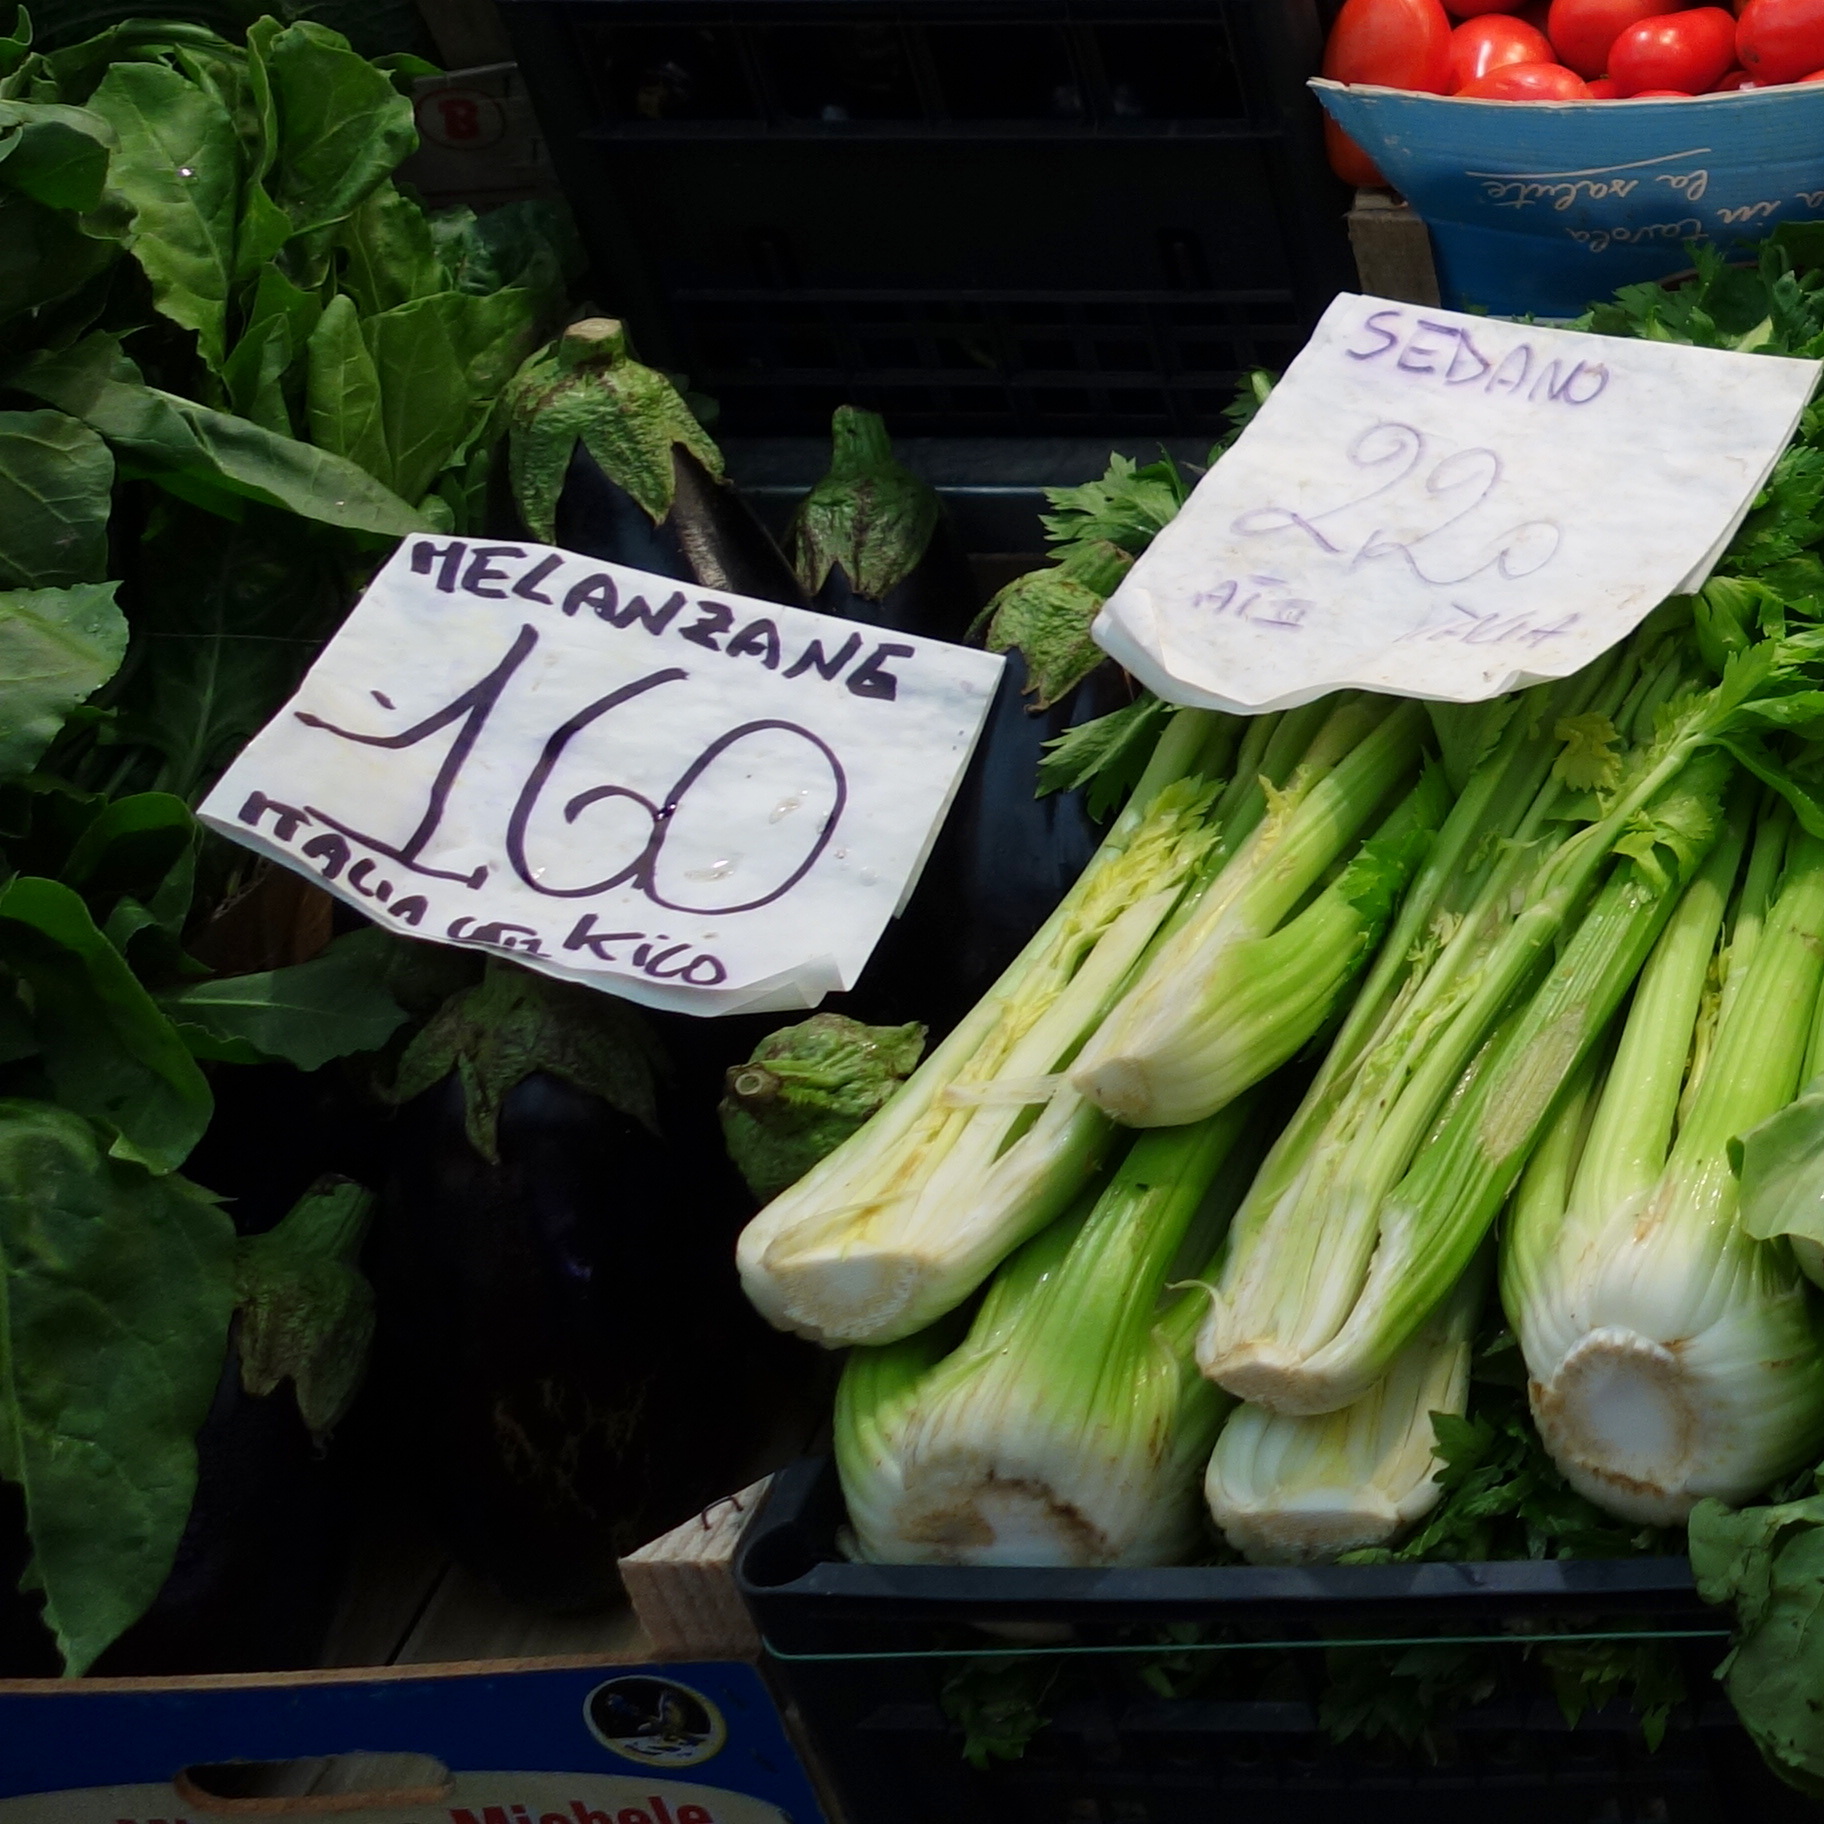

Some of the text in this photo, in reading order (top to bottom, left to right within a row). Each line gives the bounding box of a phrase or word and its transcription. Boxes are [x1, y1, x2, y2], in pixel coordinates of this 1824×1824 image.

[1480, 169, 1711, 212] la salute
[1345, 309, 1610, 407] SEDANO
[409, 538, 916, 702] MELANZANE
[237, 789, 429, 927] ITALIA
[563, 911, 727, 988] KILO
